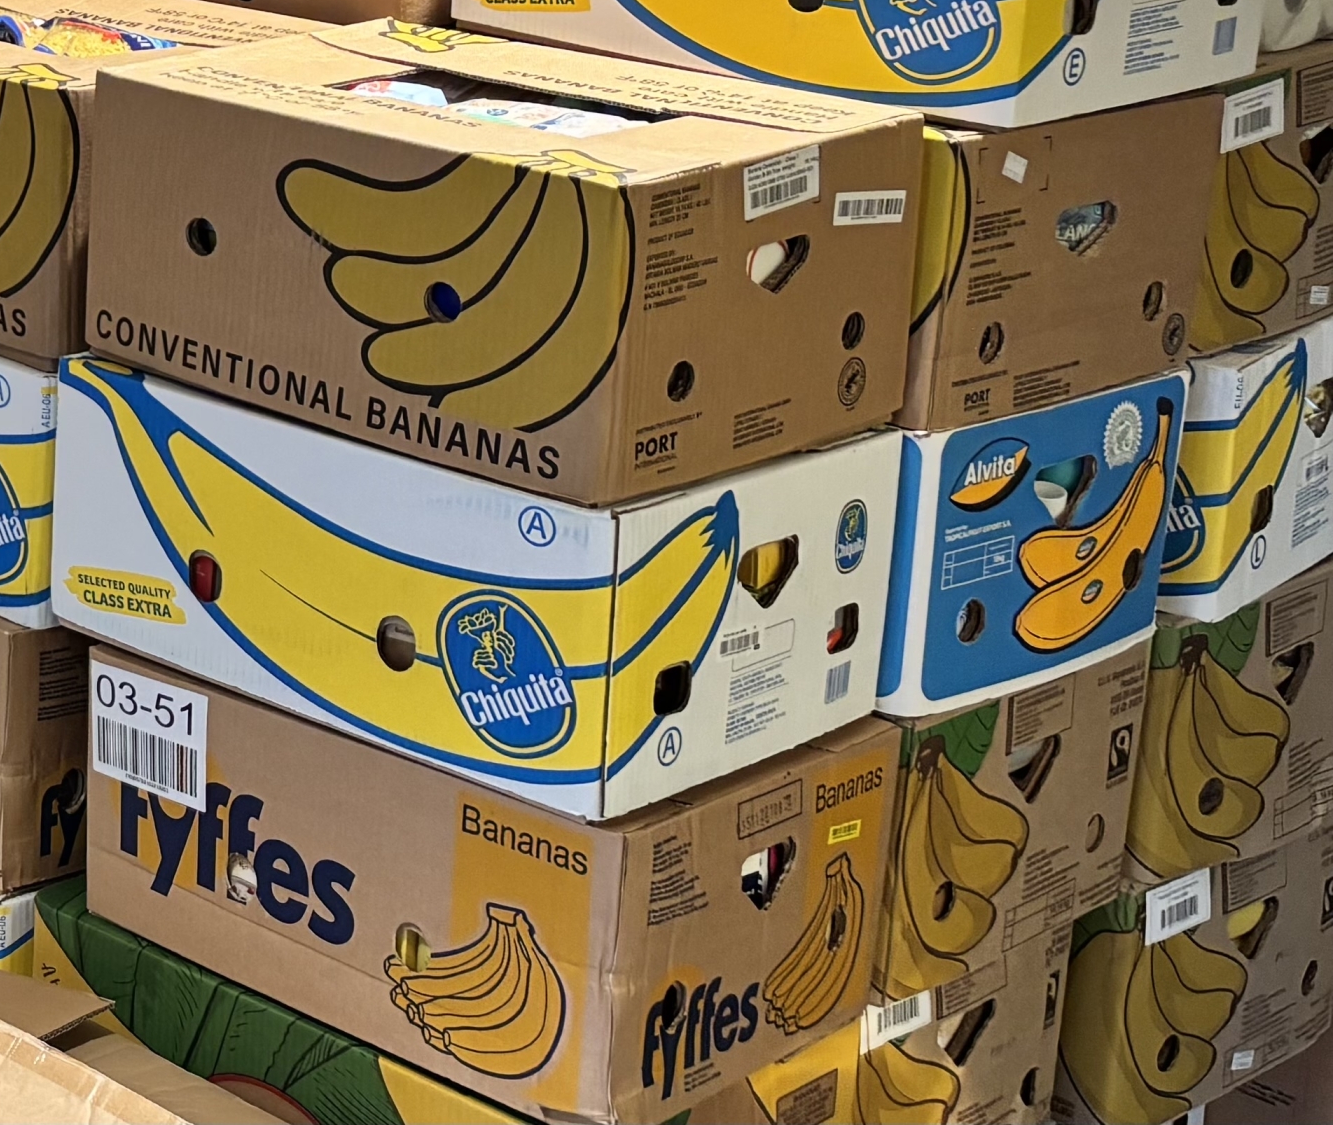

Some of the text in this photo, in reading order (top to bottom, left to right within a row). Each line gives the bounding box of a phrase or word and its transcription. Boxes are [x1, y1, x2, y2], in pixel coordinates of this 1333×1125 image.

[55, 8, 143, 28] BANANAS
[504, 70, 623, 95] BANANAS
[363, 97, 483, 129] BANANAS
[96, 308, 561, 480] CONVENTIONAL BANANAS
[964, 388, 991, 406] PORT
[635, 431, 678, 461] PORT
[964, 453, 1016, 486] Alvita
[526, 513, 548, 541] A
[77, 572, 171, 600] SELECTED QUALITY
[83, 588, 172, 620] CLASS EXTRA
[96, 673, 194, 738] 03-51
[460, 671, 573, 729] Chiquita
[660, 732, 680, 760] A
[816, 766, 883, 814] Bananas
[461, 802, 588, 877] Bananas
